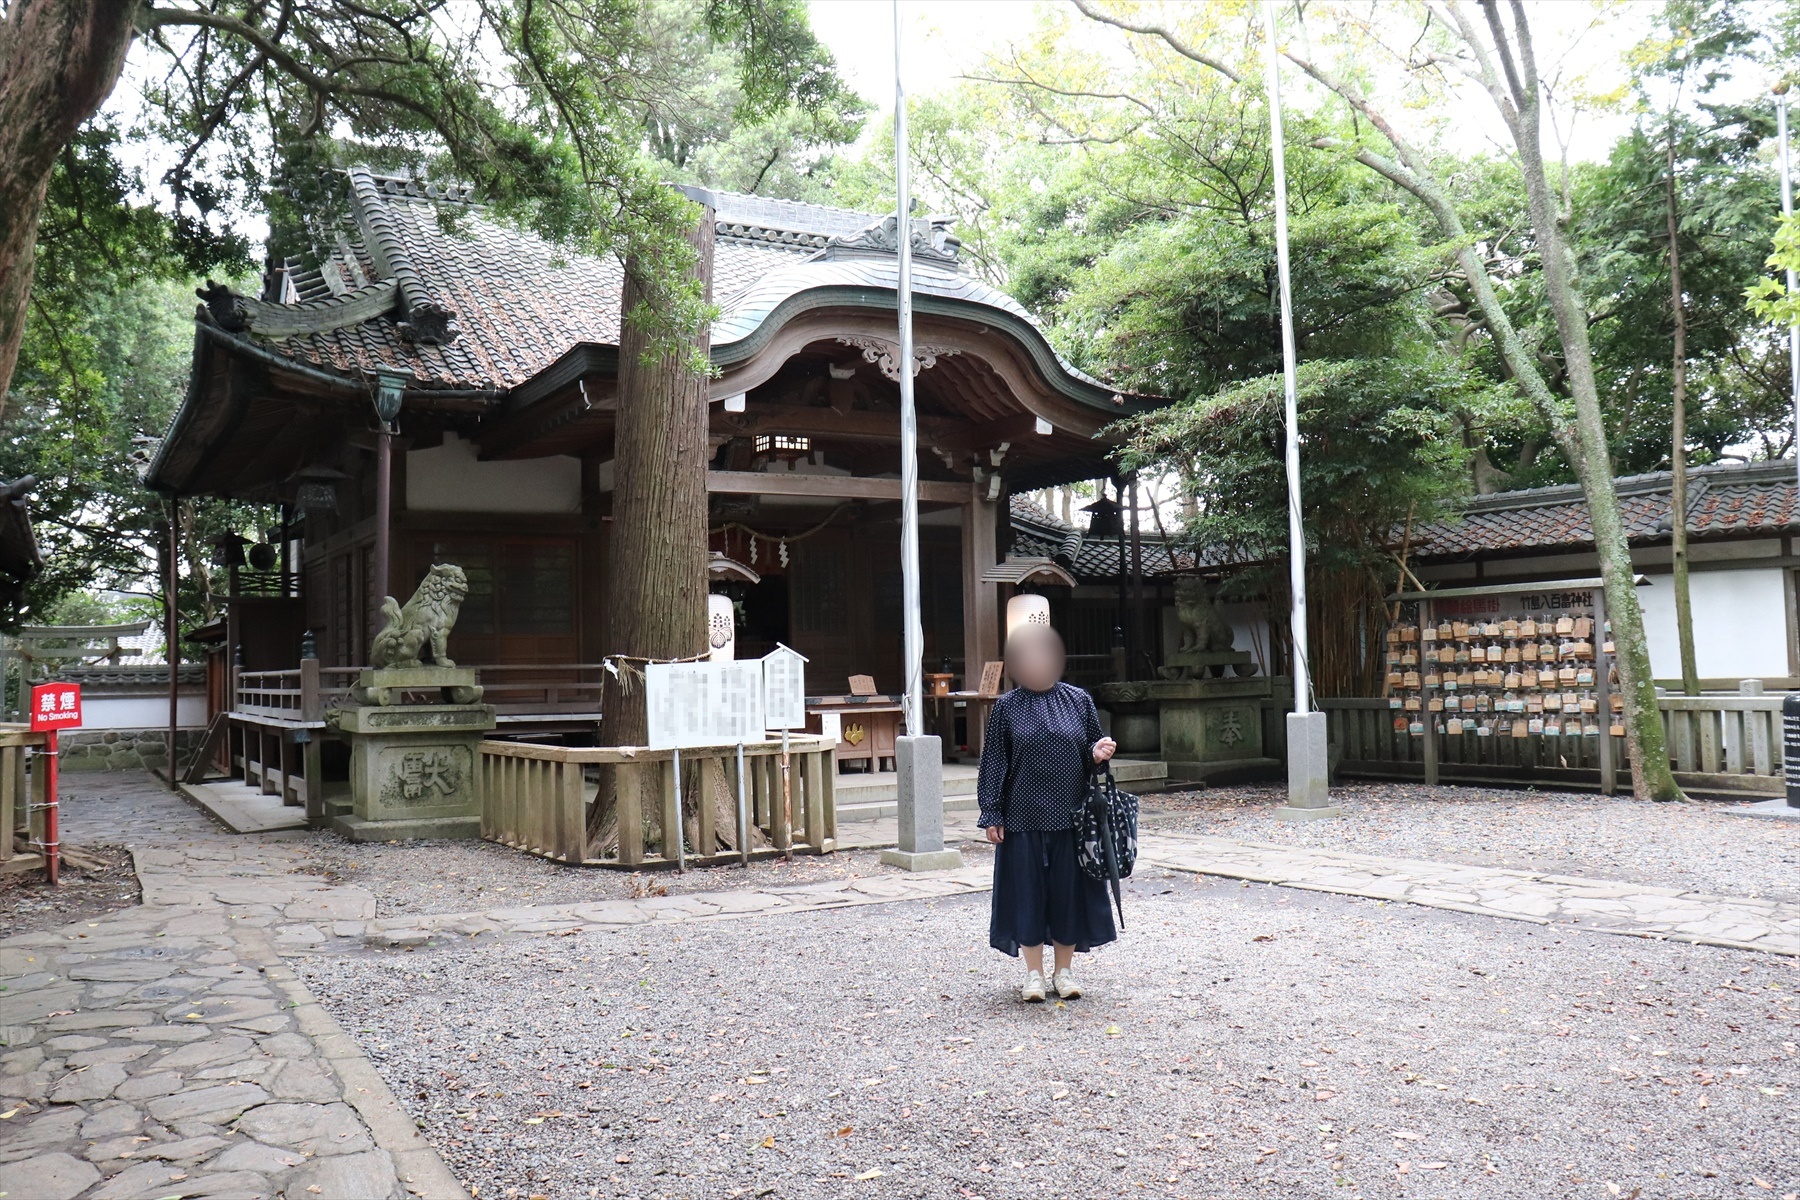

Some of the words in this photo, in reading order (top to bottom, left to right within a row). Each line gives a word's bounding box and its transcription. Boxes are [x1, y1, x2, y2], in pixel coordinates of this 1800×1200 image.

[1520, 591, 1594, 611] 竹島八百富神社
[41, 692, 76, 712] 禁煙
[37, 713, 48, 722] No
[48, 711, 79, 721] Smoking
